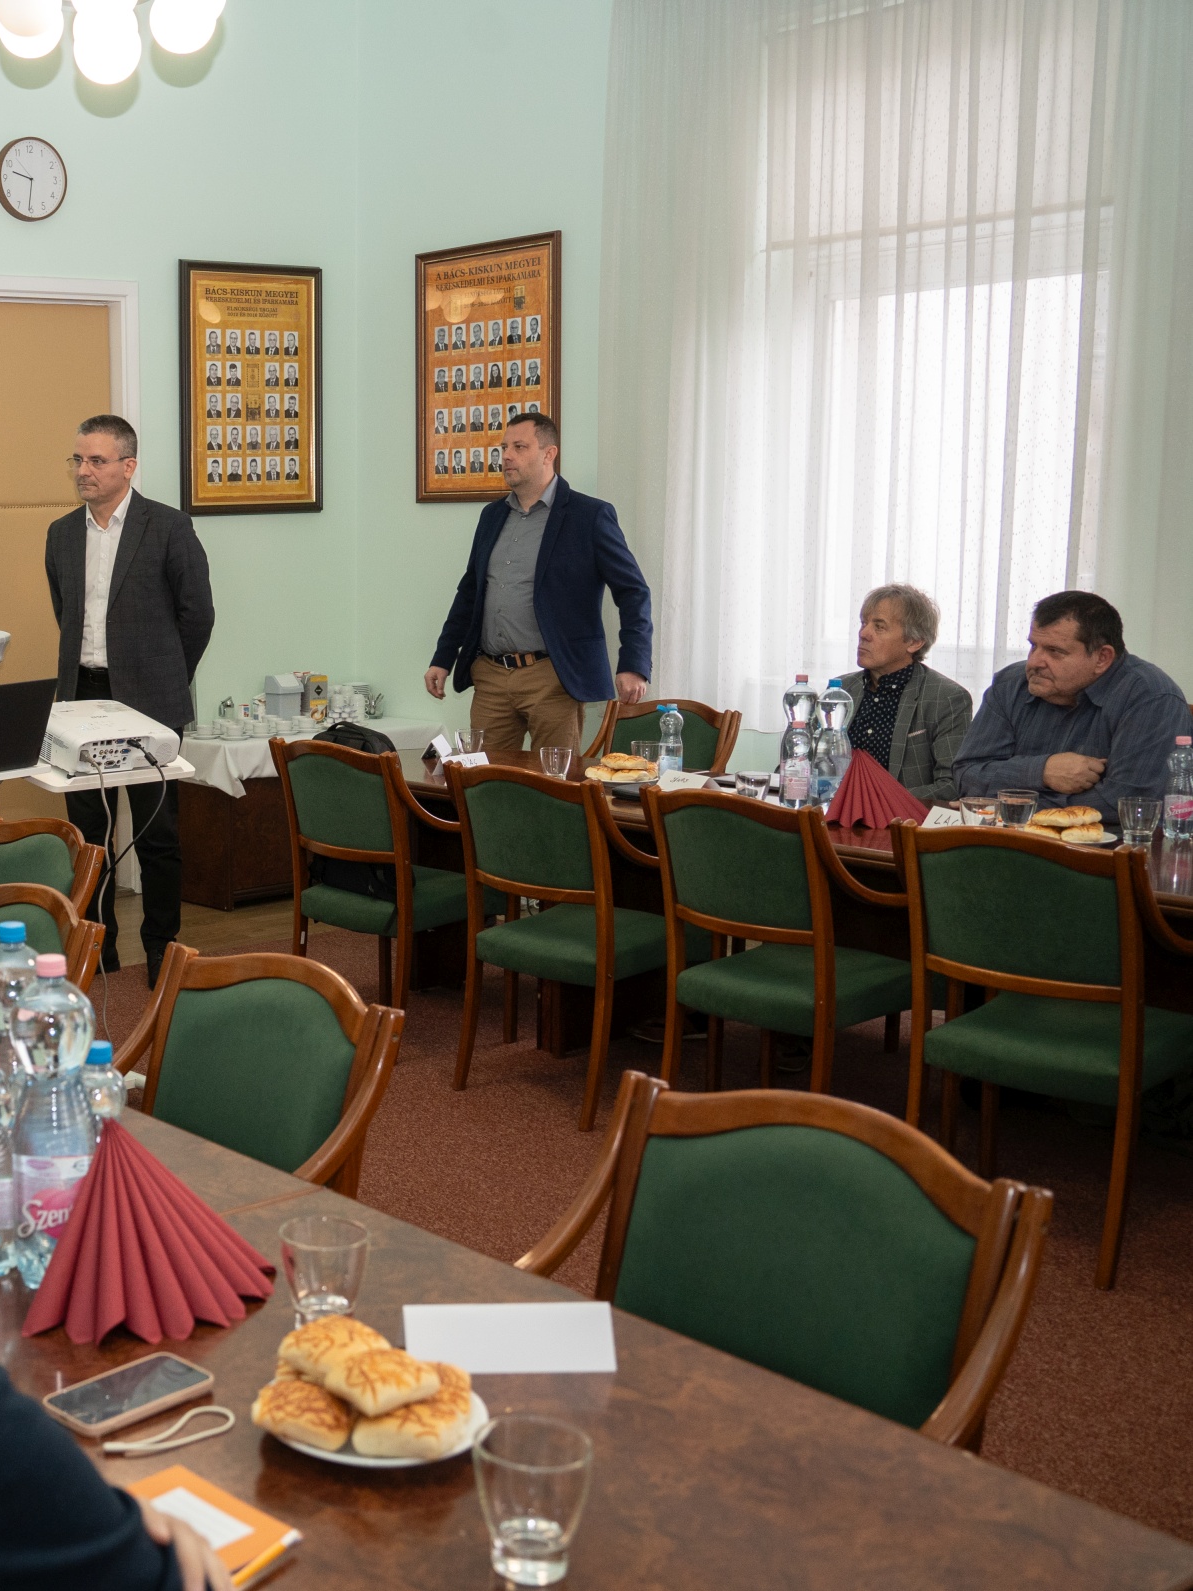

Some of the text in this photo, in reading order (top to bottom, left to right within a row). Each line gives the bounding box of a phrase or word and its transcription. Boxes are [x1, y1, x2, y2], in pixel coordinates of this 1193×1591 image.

[14, 149, 21, 157] 11
[26, 145, 34, 154] 12
[5, 159, 13, 168] 10
[49, 161, 55, 170] 2
[2, 174, 8, 182] 9
[52, 176, 58, 185] 3
[6, 189, 12, 198] 8
[50, 191, 55, 200] 4
[16, 201, 22, 209] 7
[29, 205, 34, 214] 6
[41, 201, 46, 211] 5
[435, 256, 541, 281] A BÁCS-KISKUN MEGYEI
[435, 269, 541, 292] KERESKEDELMI ÉS IPARKAMARA
[205, 286, 299, 299] BÁCS-KISKUN MEGYEI
[206, 296, 252, 304] KERESKEDELMI
[17, 1199, 73, 1239] Szen
